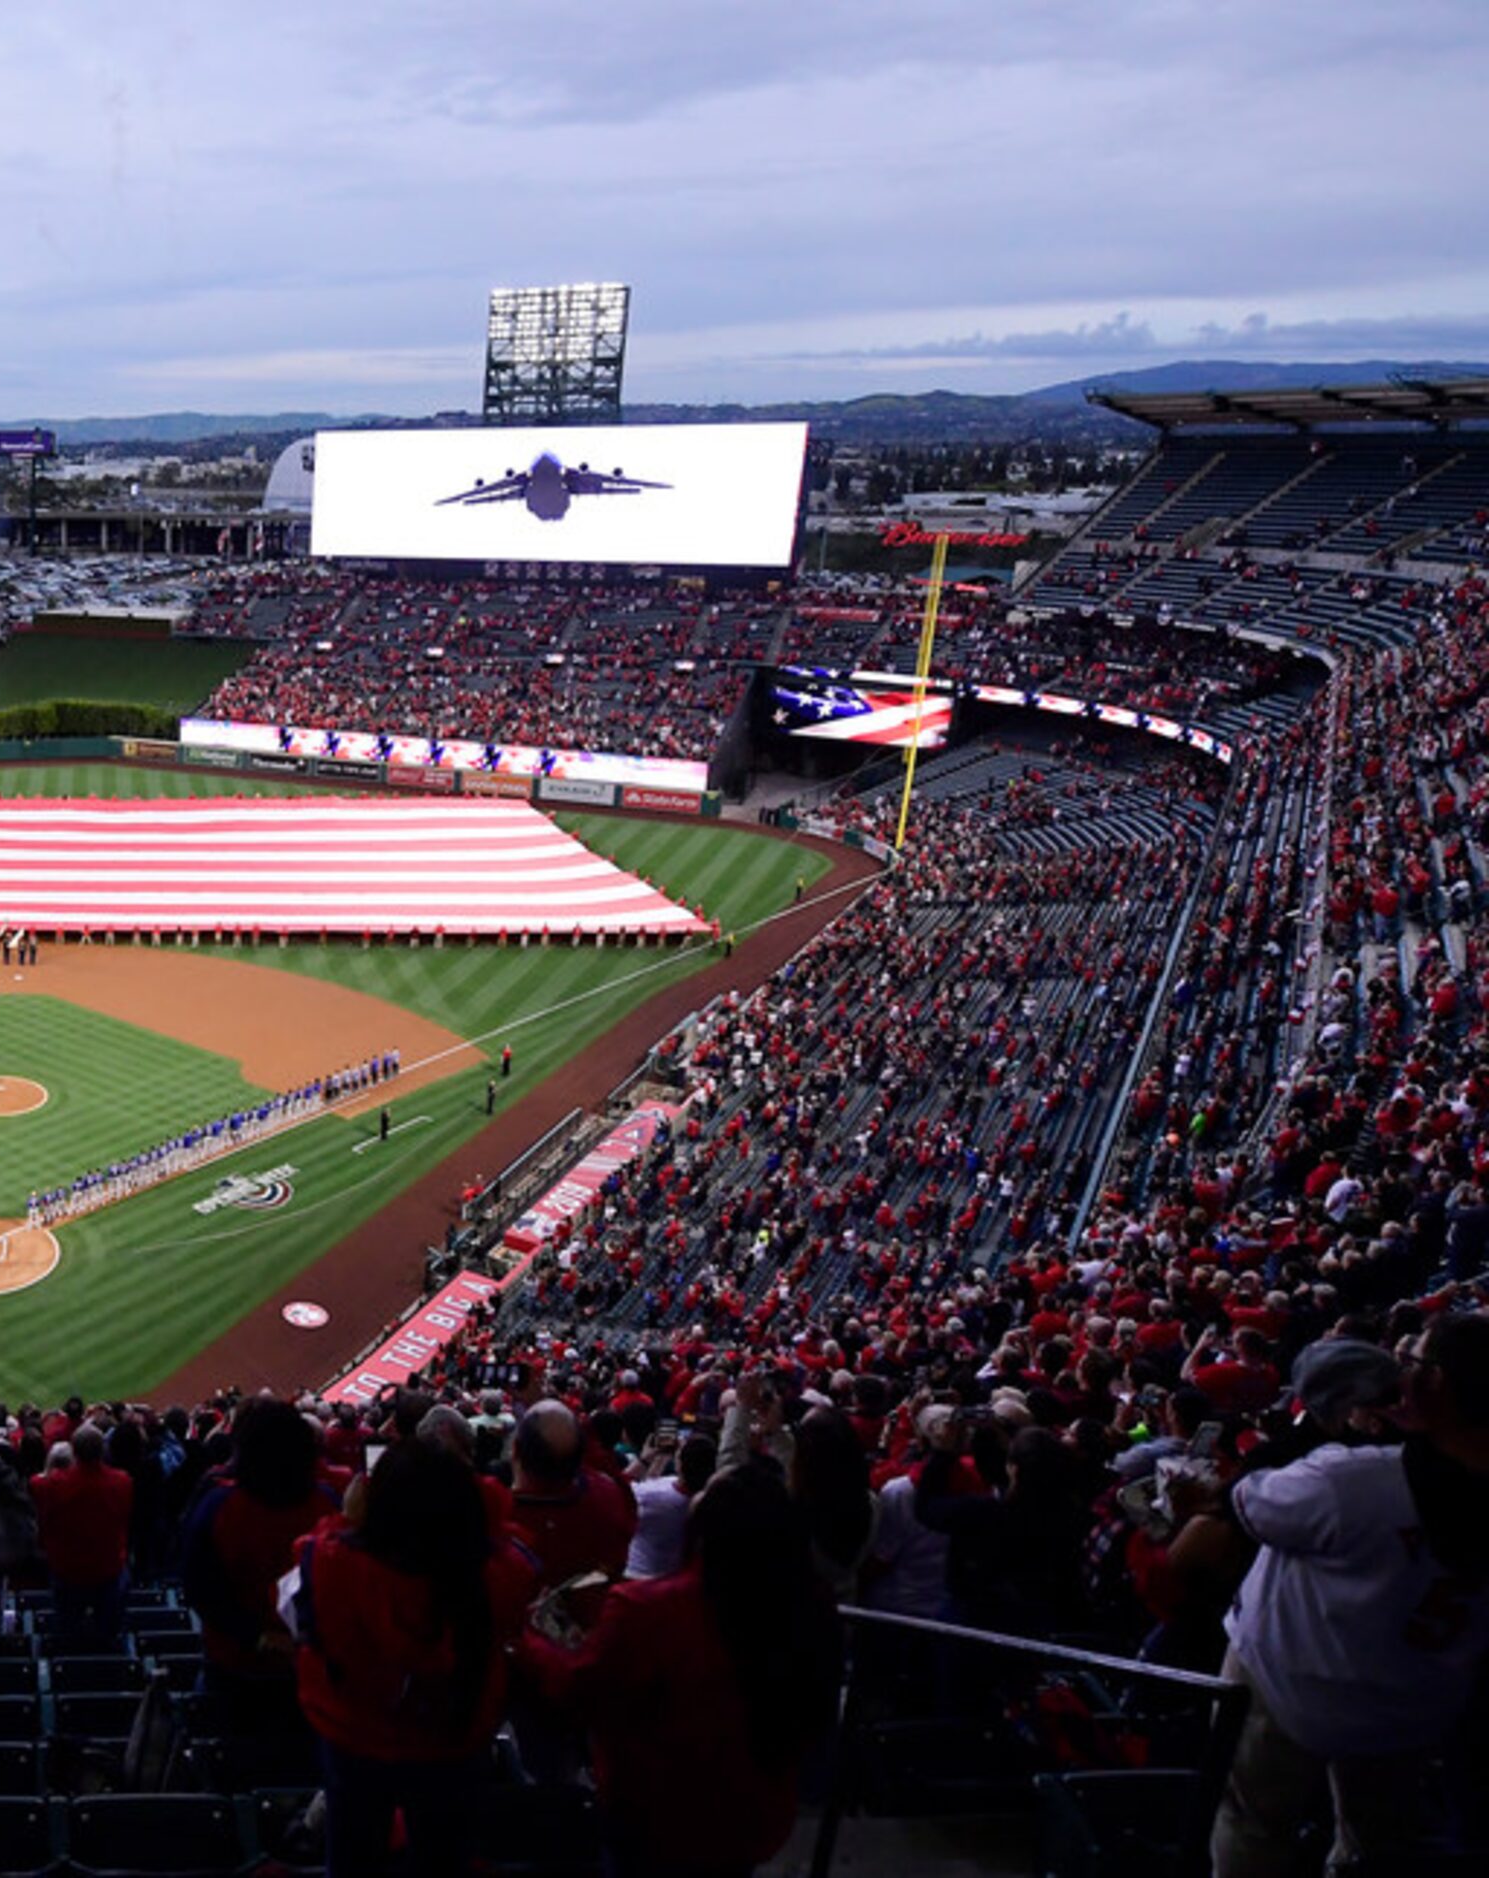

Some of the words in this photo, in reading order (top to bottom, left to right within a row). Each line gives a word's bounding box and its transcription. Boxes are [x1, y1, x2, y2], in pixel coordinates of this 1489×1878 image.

[380, 1329, 439, 1368] THE
[425, 1295, 475, 1330] BIG
[460, 1279, 497, 1297] A
